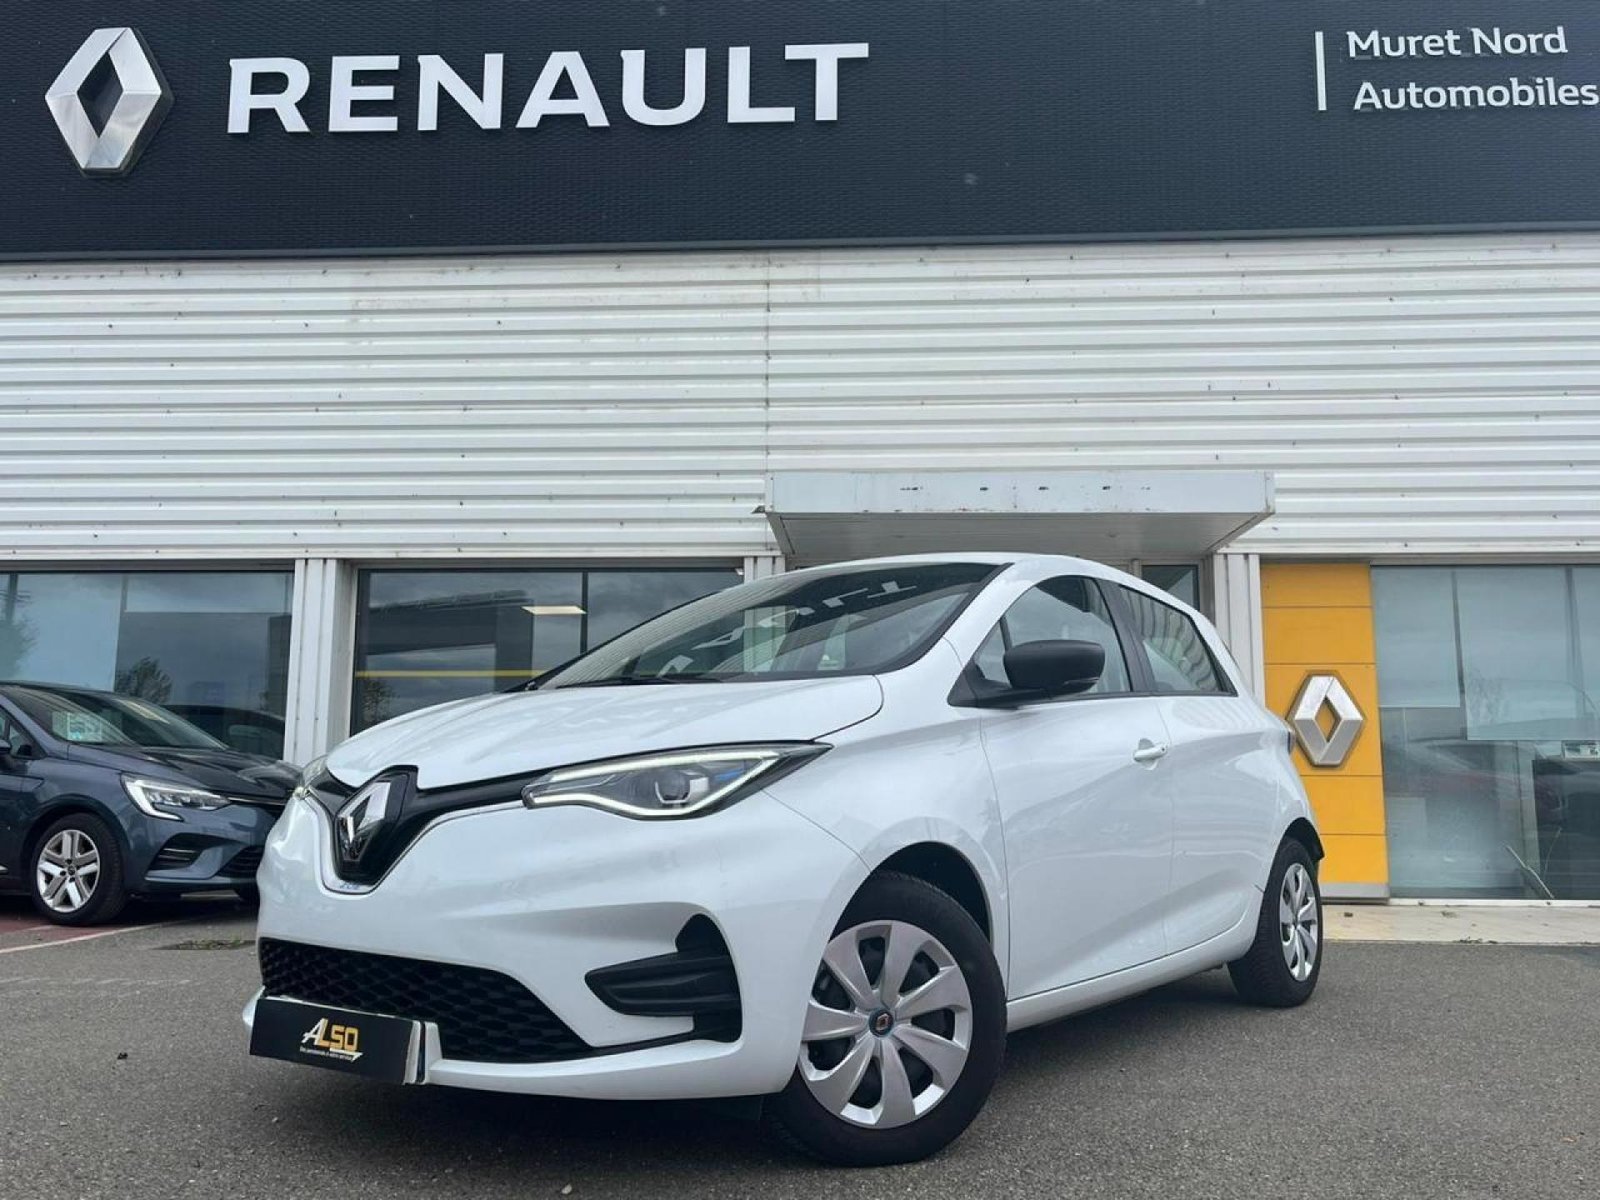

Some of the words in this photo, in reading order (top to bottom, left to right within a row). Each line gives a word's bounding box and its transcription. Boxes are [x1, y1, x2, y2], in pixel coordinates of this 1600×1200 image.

[1346, 29, 1461, 57] Muret
[1471, 26, 1568, 54] Nord
[227, 43, 869, 133] RENAULT
[1353, 77, 1600, 110] Automobiles
[301, 1018, 359, 1051] ALSO
